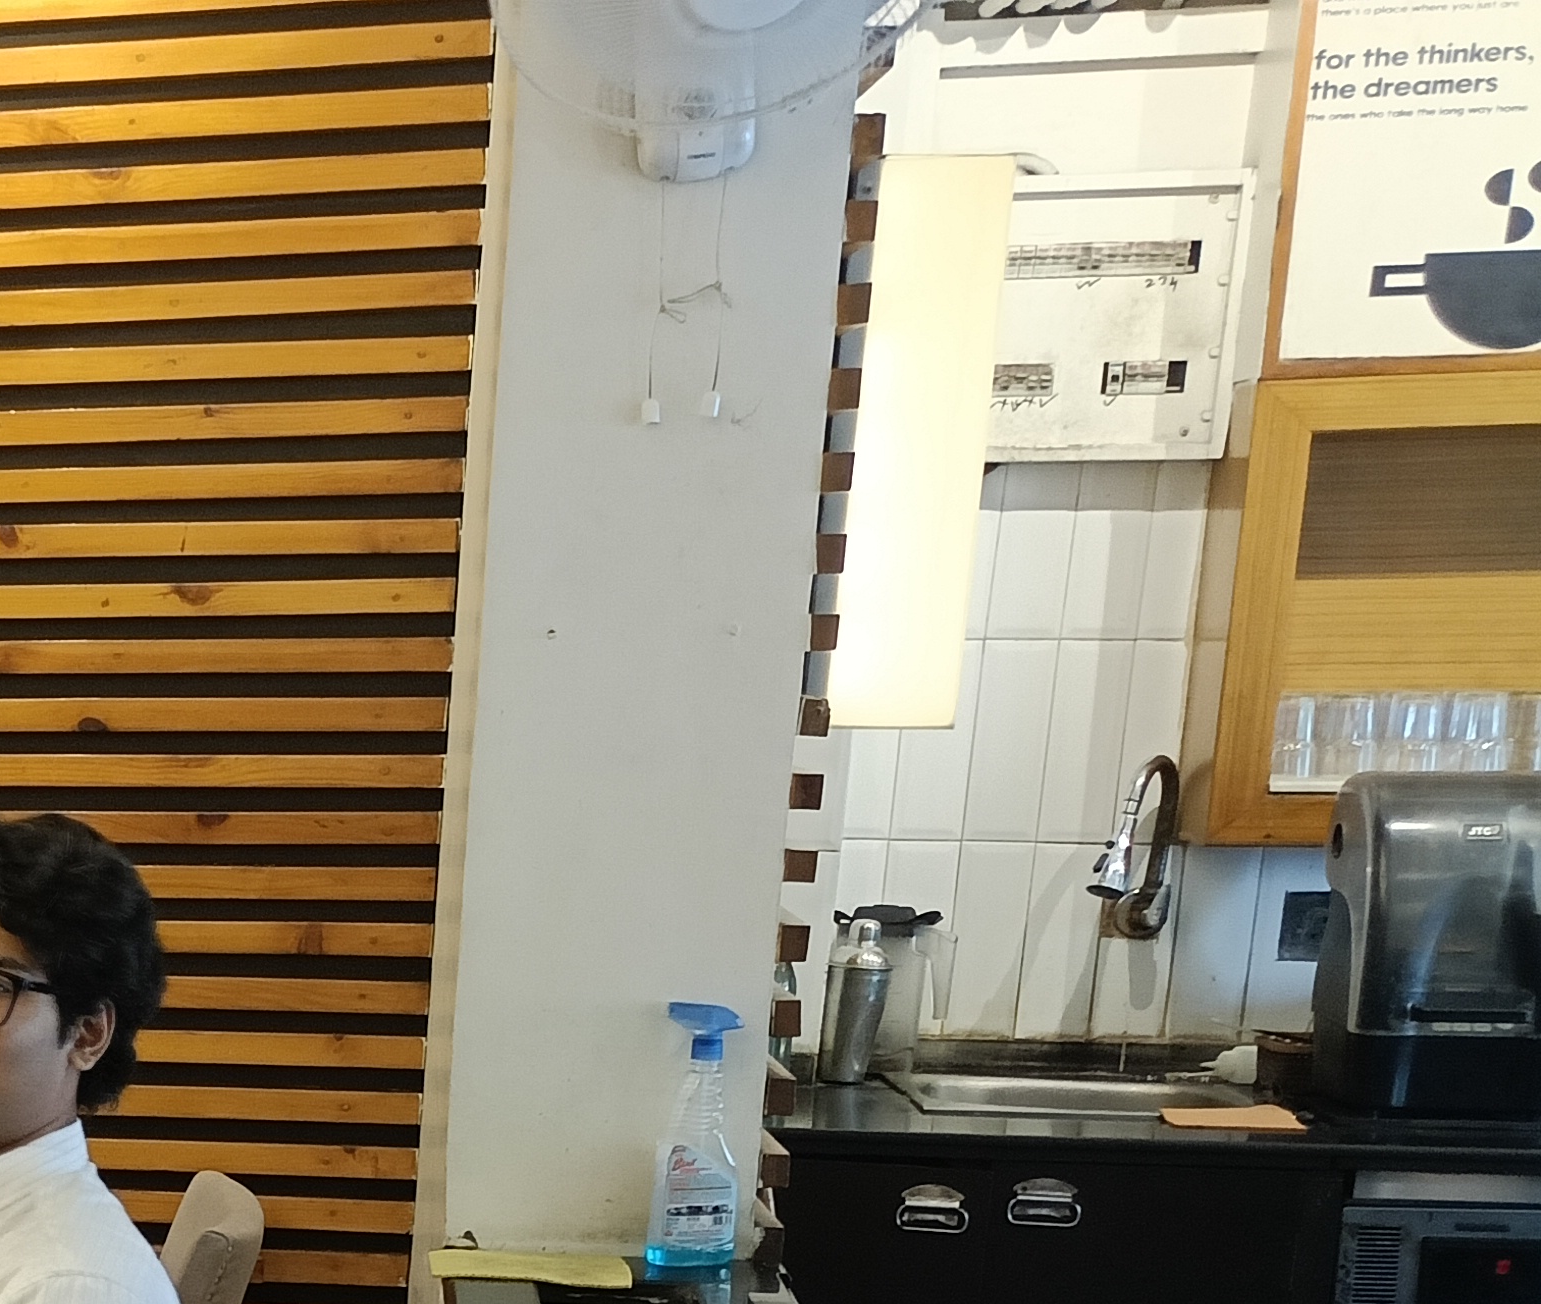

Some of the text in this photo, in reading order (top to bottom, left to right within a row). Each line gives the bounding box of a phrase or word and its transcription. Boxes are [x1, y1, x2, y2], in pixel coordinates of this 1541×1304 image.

[1373, 6, 1408, 16] place
[1315, 42, 1535, 70] for the thinkers,
[1310, 76, 1498, 100] the dreamers
